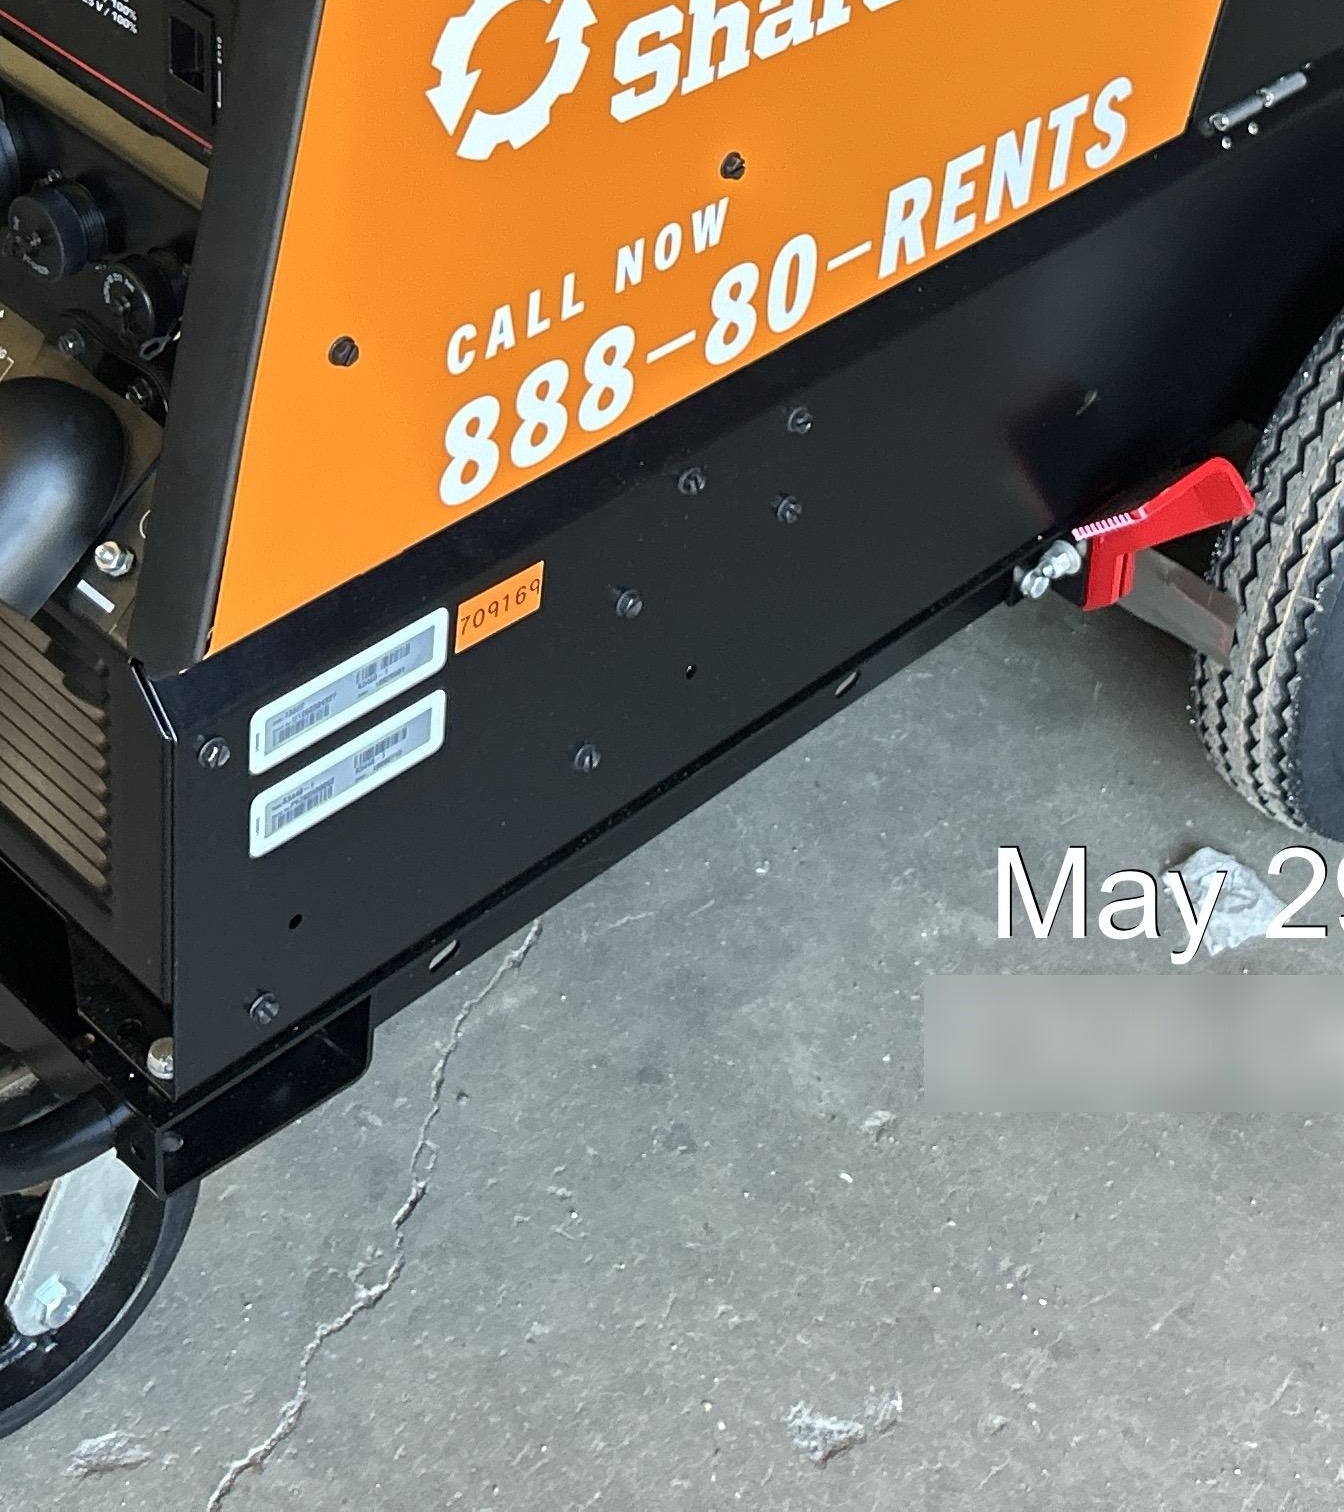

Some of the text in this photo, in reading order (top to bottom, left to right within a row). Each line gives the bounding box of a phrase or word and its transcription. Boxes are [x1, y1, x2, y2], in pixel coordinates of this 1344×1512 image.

[436, 76, 1136, 508] 888-80-RENTS
[445, 196, 733, 376] CALL NOW
[459, 577, 543, 638] 709169
